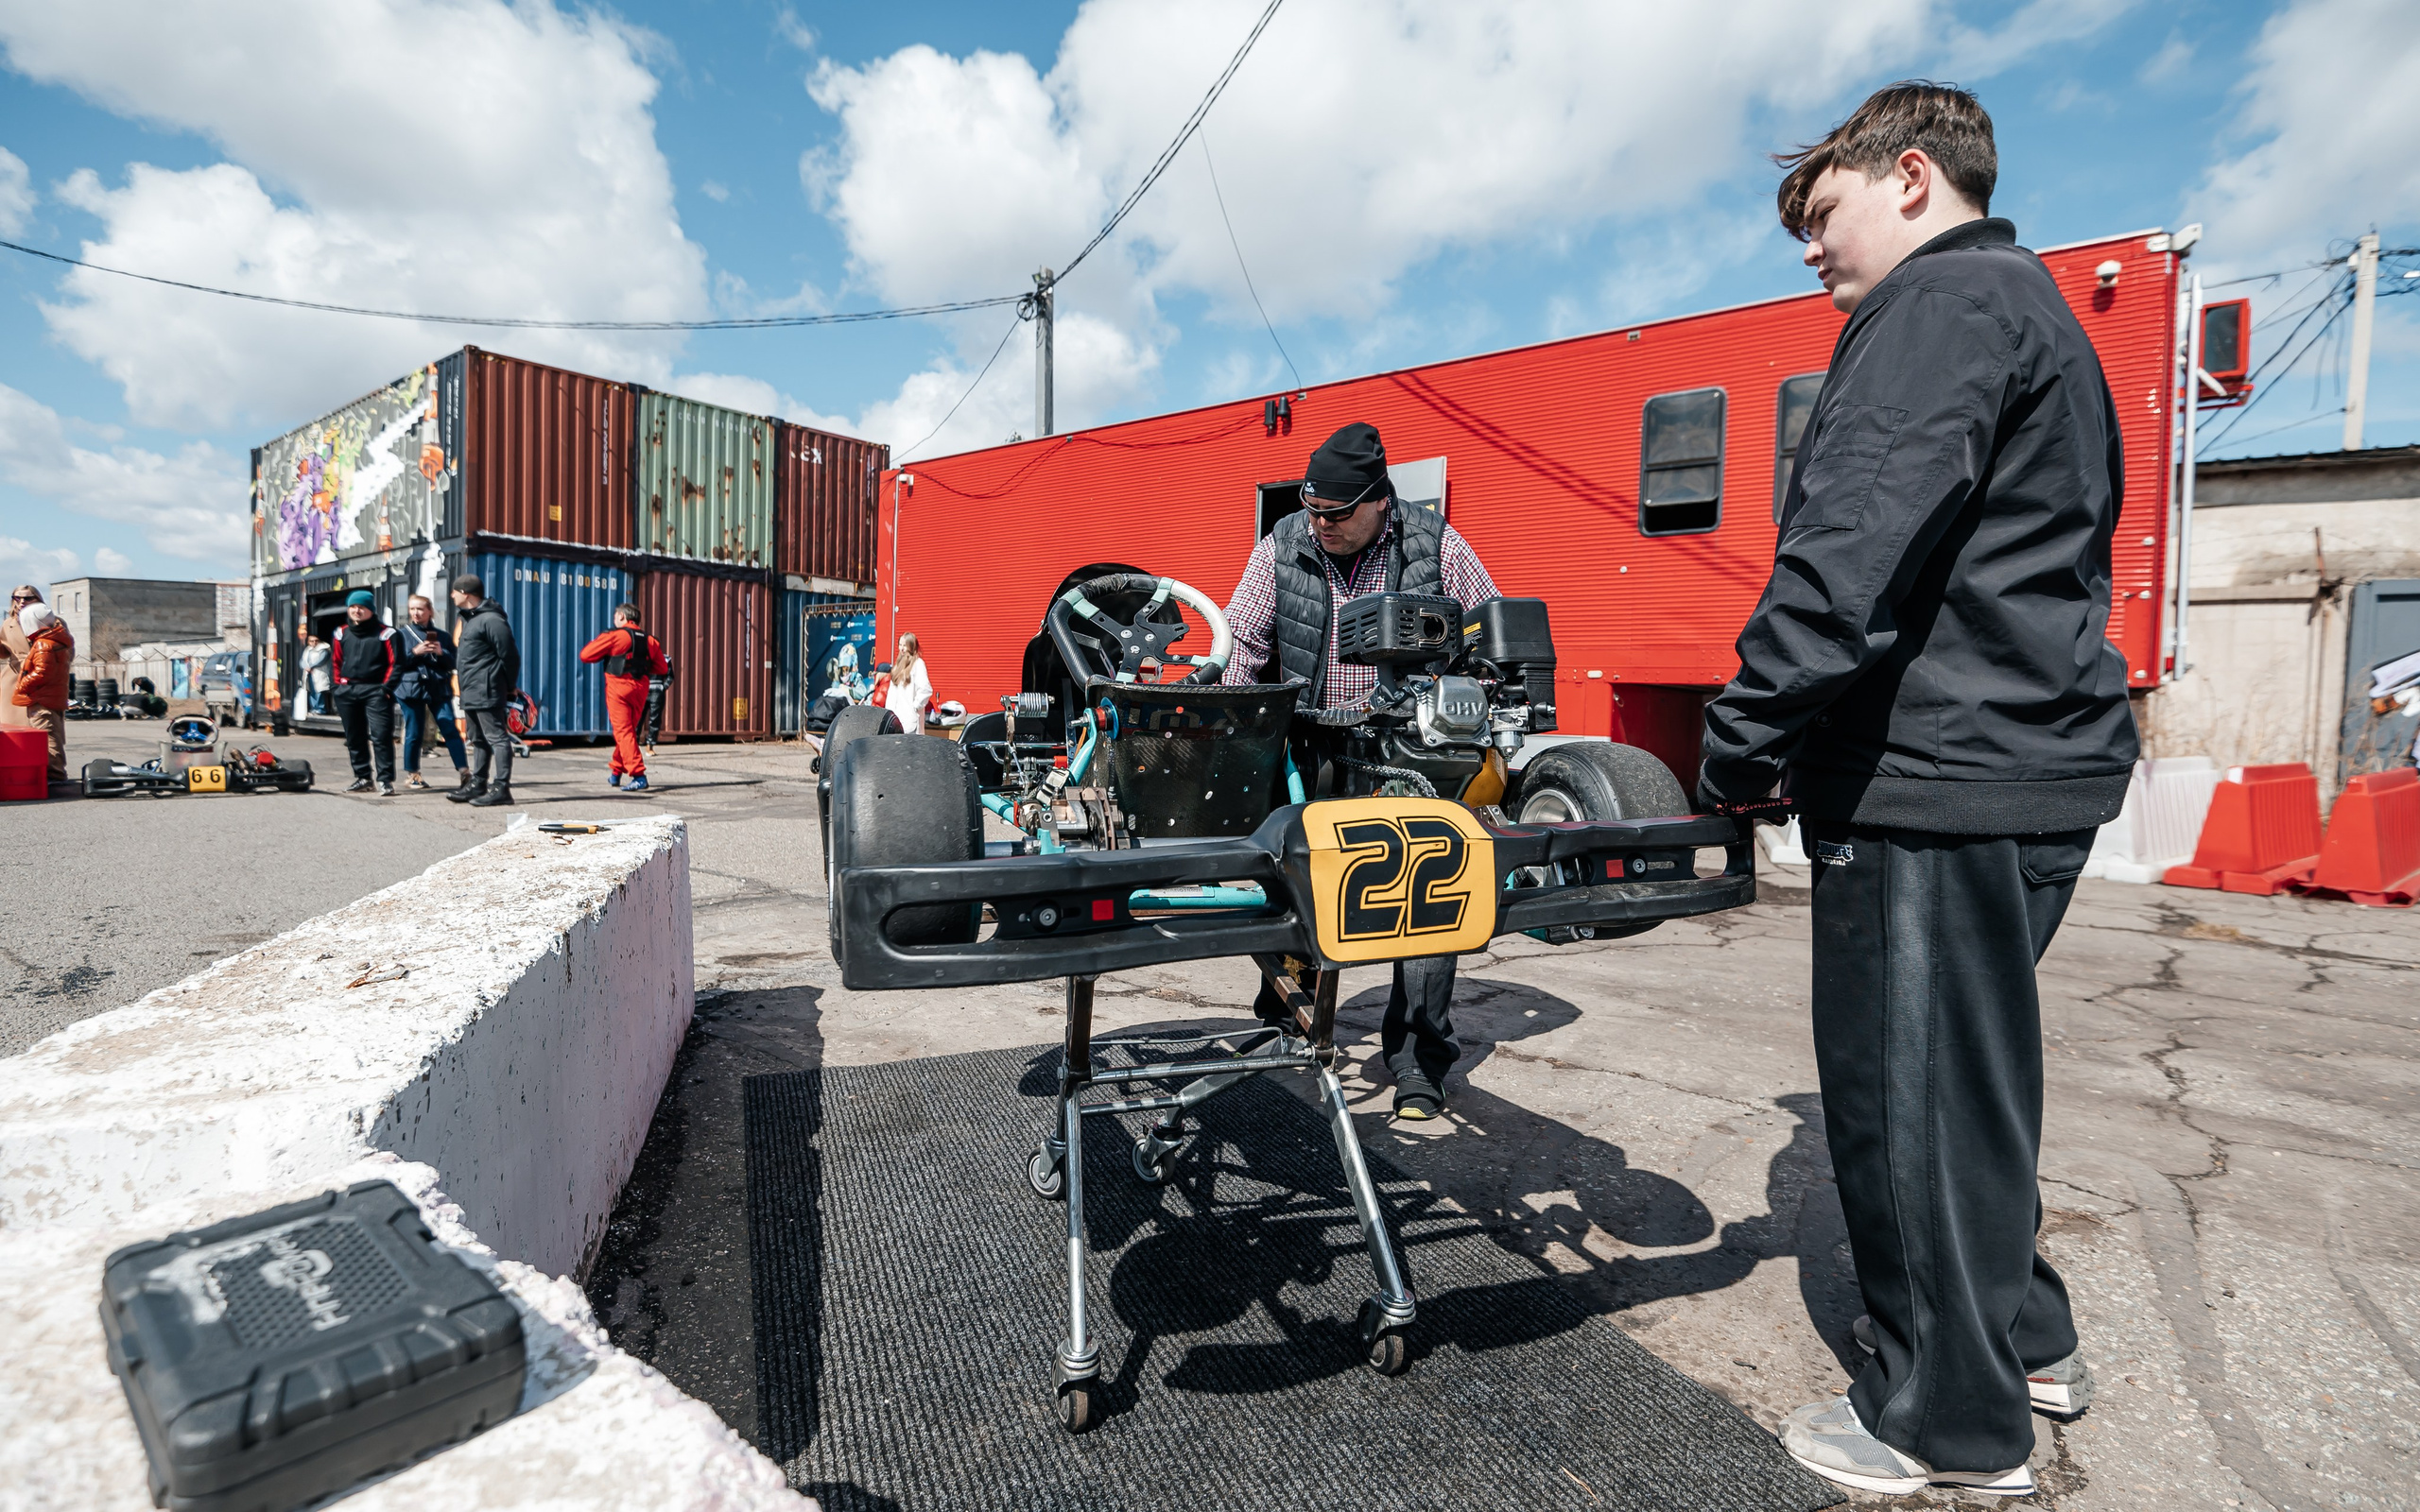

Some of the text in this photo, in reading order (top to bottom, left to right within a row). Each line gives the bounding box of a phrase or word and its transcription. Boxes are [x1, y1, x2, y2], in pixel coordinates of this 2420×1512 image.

[514, 569, 550, 584] DNAU
[1443, 701, 1483, 715] OHV
[192, 768, 221, 783] 66
[1334, 815, 1472, 943] 22
